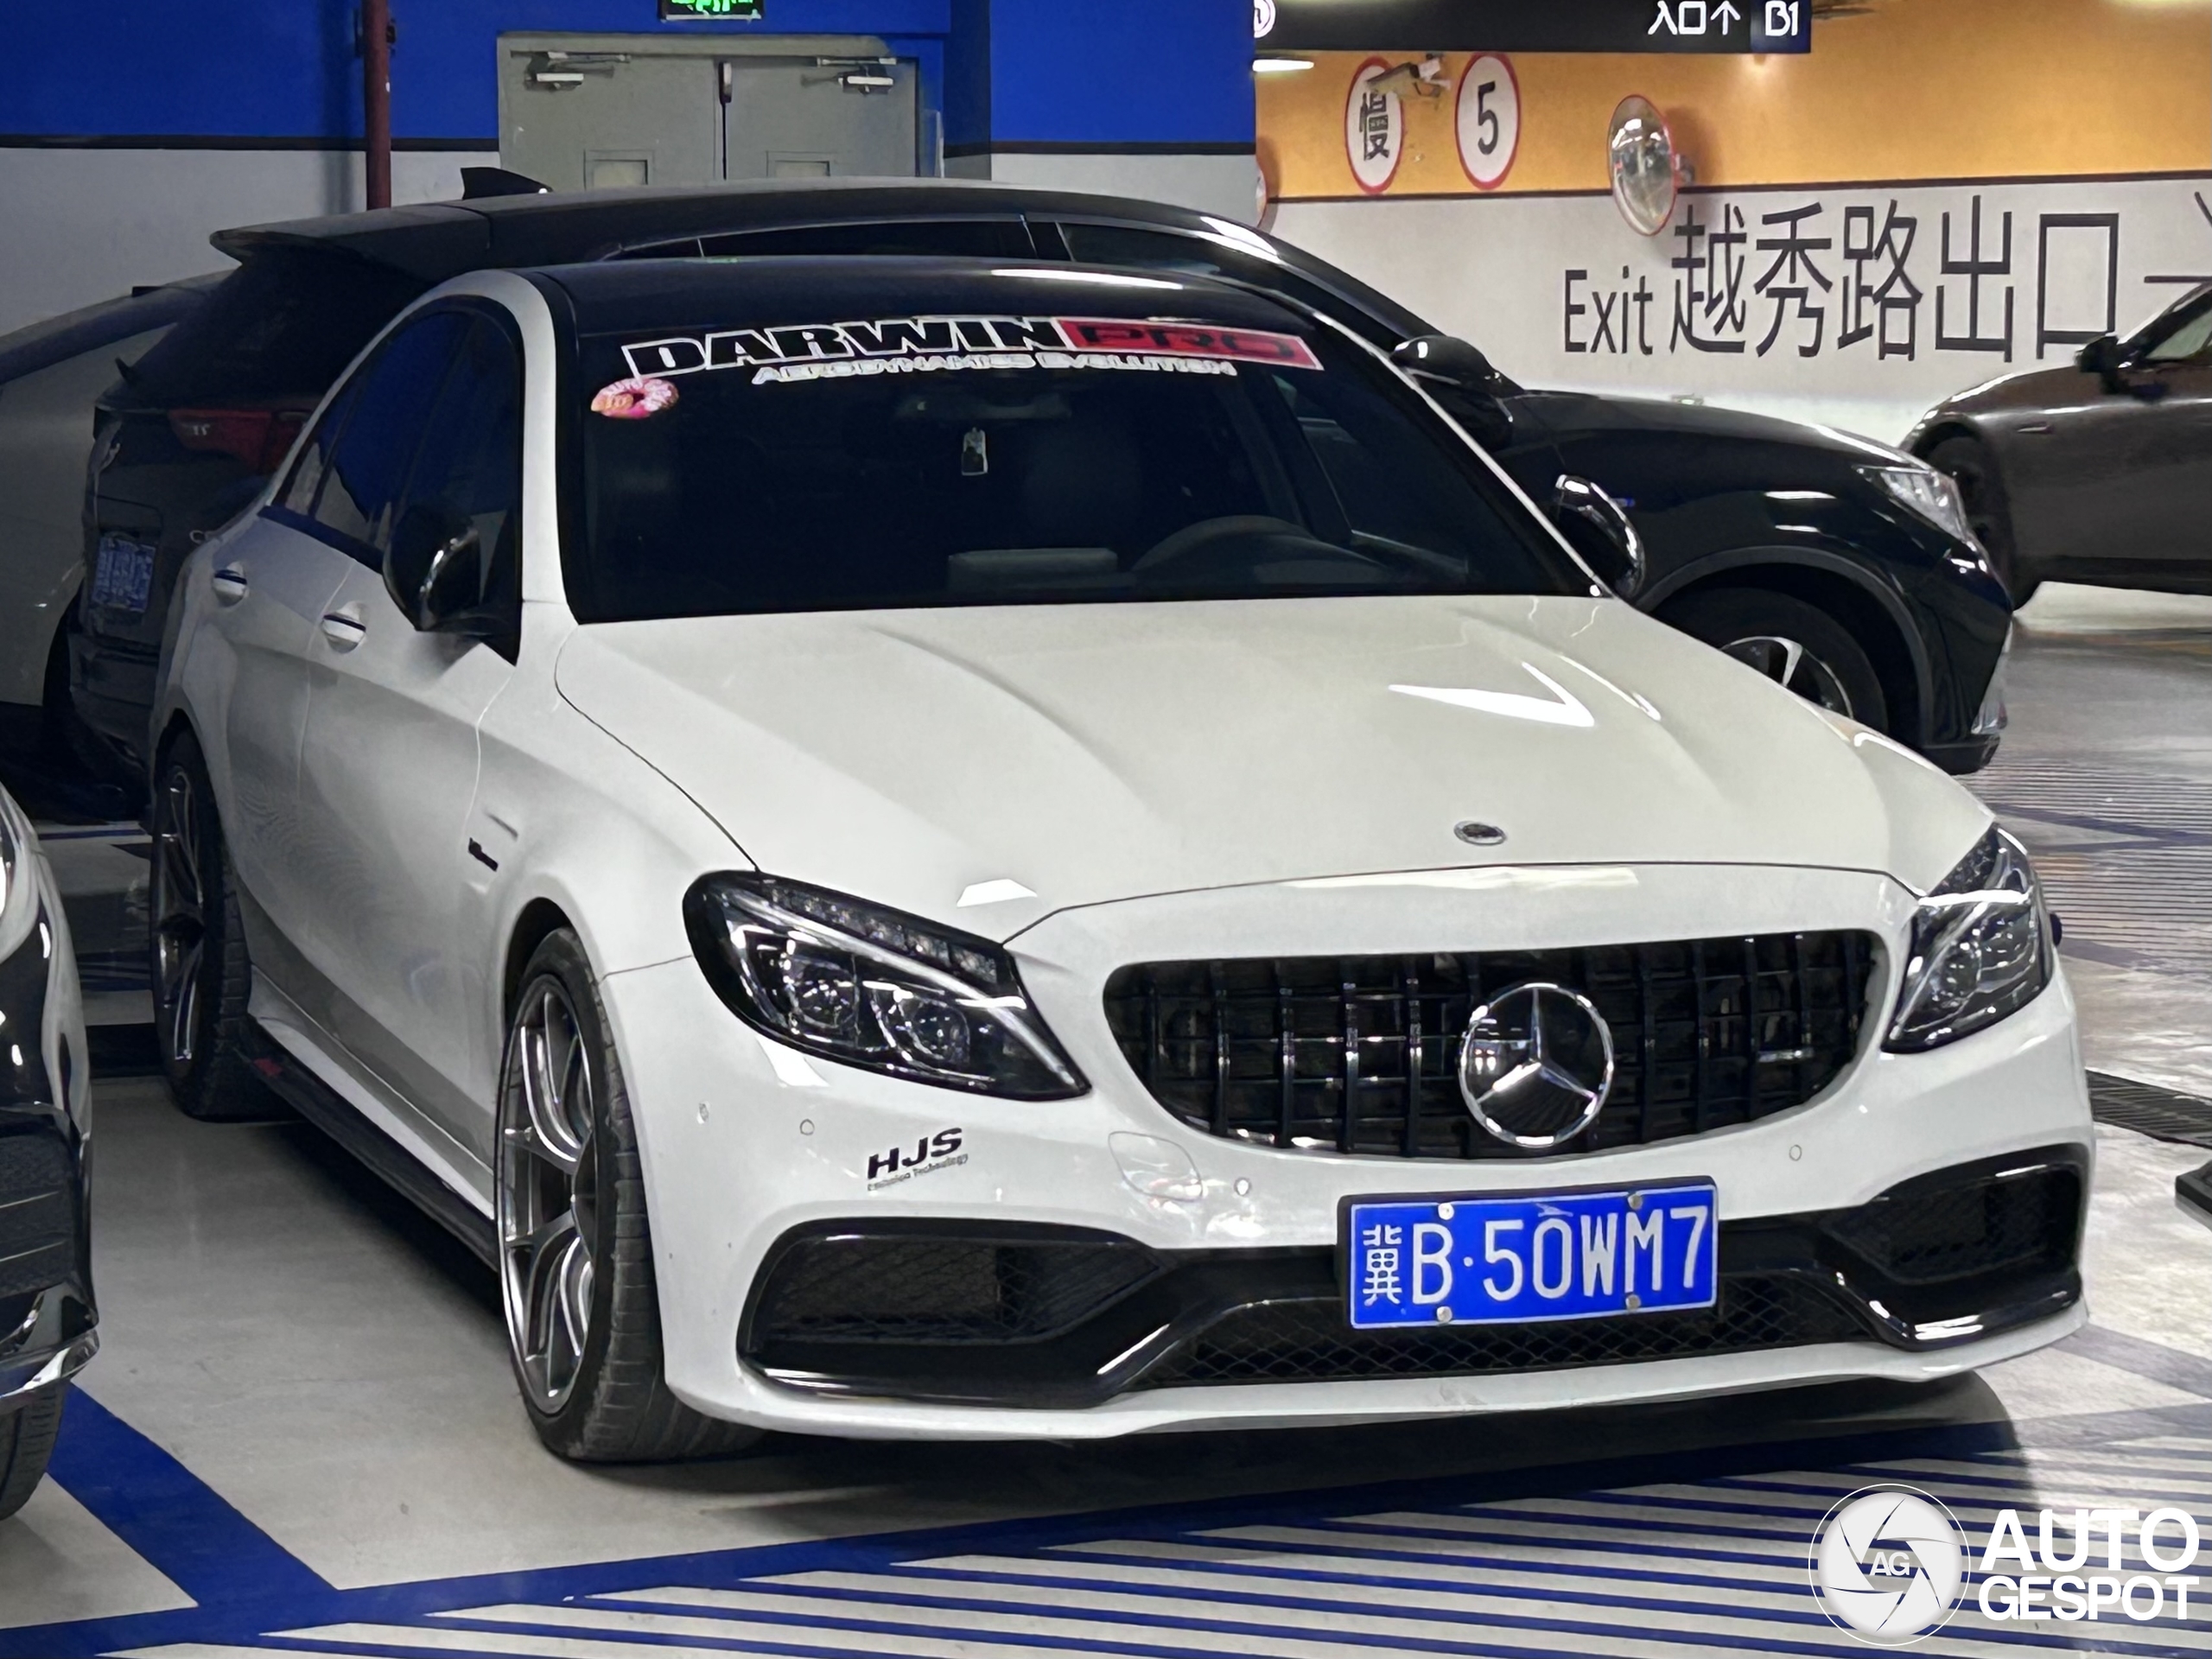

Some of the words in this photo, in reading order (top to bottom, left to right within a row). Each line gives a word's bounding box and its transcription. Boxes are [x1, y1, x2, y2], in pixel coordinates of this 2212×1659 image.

[1648, 1, 1707, 35] 入口
[1765, 1, 1799, 36] B1
[1359, 90, 1390, 162] 慢
[1478, 80, 1499, 156] 5
[1565, 265, 1654, 355] Exit
[1670, 195, 2120, 363] 越秀路出口
[621, 316, 1070, 378] DARWIN
[868, 1128, 963, 1180] HJS
